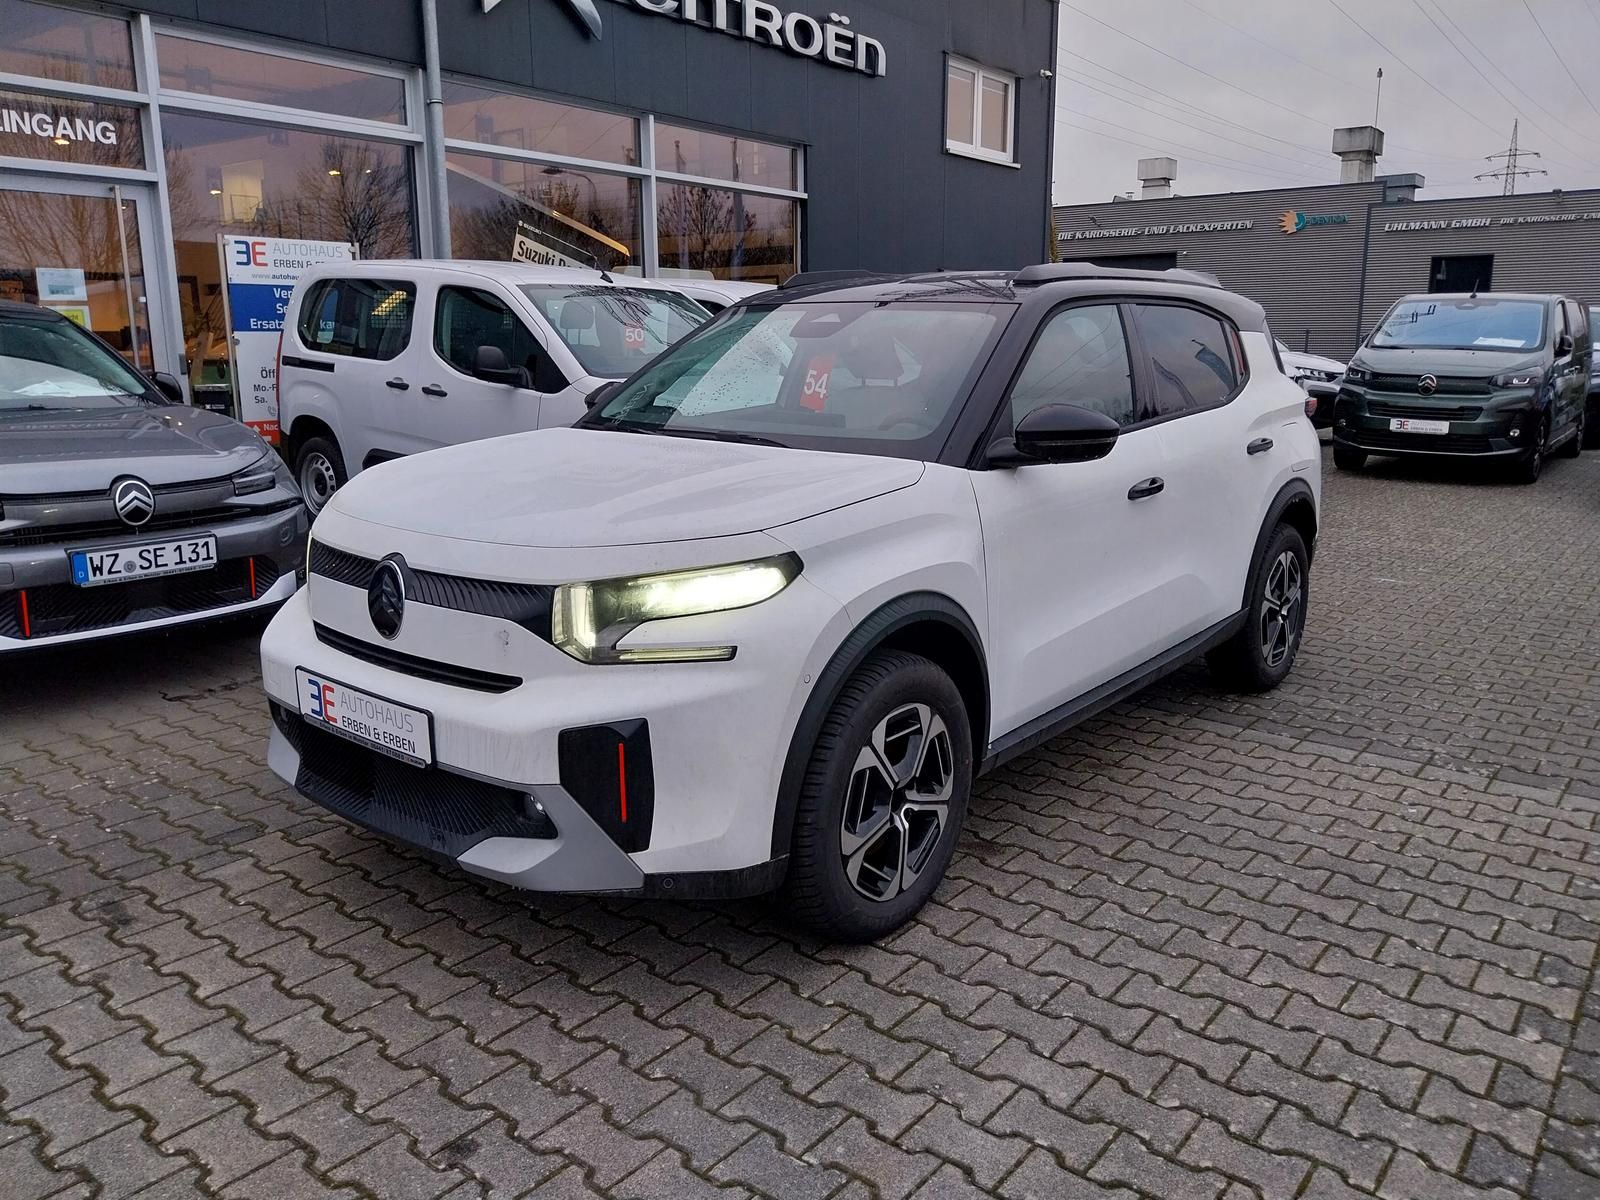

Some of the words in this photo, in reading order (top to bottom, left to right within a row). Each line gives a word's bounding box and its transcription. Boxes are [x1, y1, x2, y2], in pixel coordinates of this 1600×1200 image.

[632, 0, 887, 77] TROËN
[0, 109, 117, 145] INGANG
[1058, 231, 1073, 241] DIE
[1075, 227, 1142, 239] KAROSSERIE-
[1145, 225, 1167, 235] UND
[1169, 220, 1254, 233] LACKEXPERTEN
[1384, 220, 1448, 232] UHLMANN
[1451, 217, 1491, 228] GMBH
[273, 242, 343, 258] AUTOHAUS
[517, 240, 556, 266] Suzuki
[273, 259, 304, 269] ERBEN
[625, 328, 644, 342] 50
[253, 383, 278, 392] Mo.-F
[804, 369, 828, 399] 54
[254, 395, 268, 404] Sa.
[89, 553, 122, 577] WZ
[138, 547, 168, 570] SE
[173, 541, 214, 566] 131
[340, 691, 414, 733] AUTOHAUS
[342, 715, 372, 738] ERBEN
[373, 728, 382, 741] &
[383, 731, 416, 754] ERBEN
